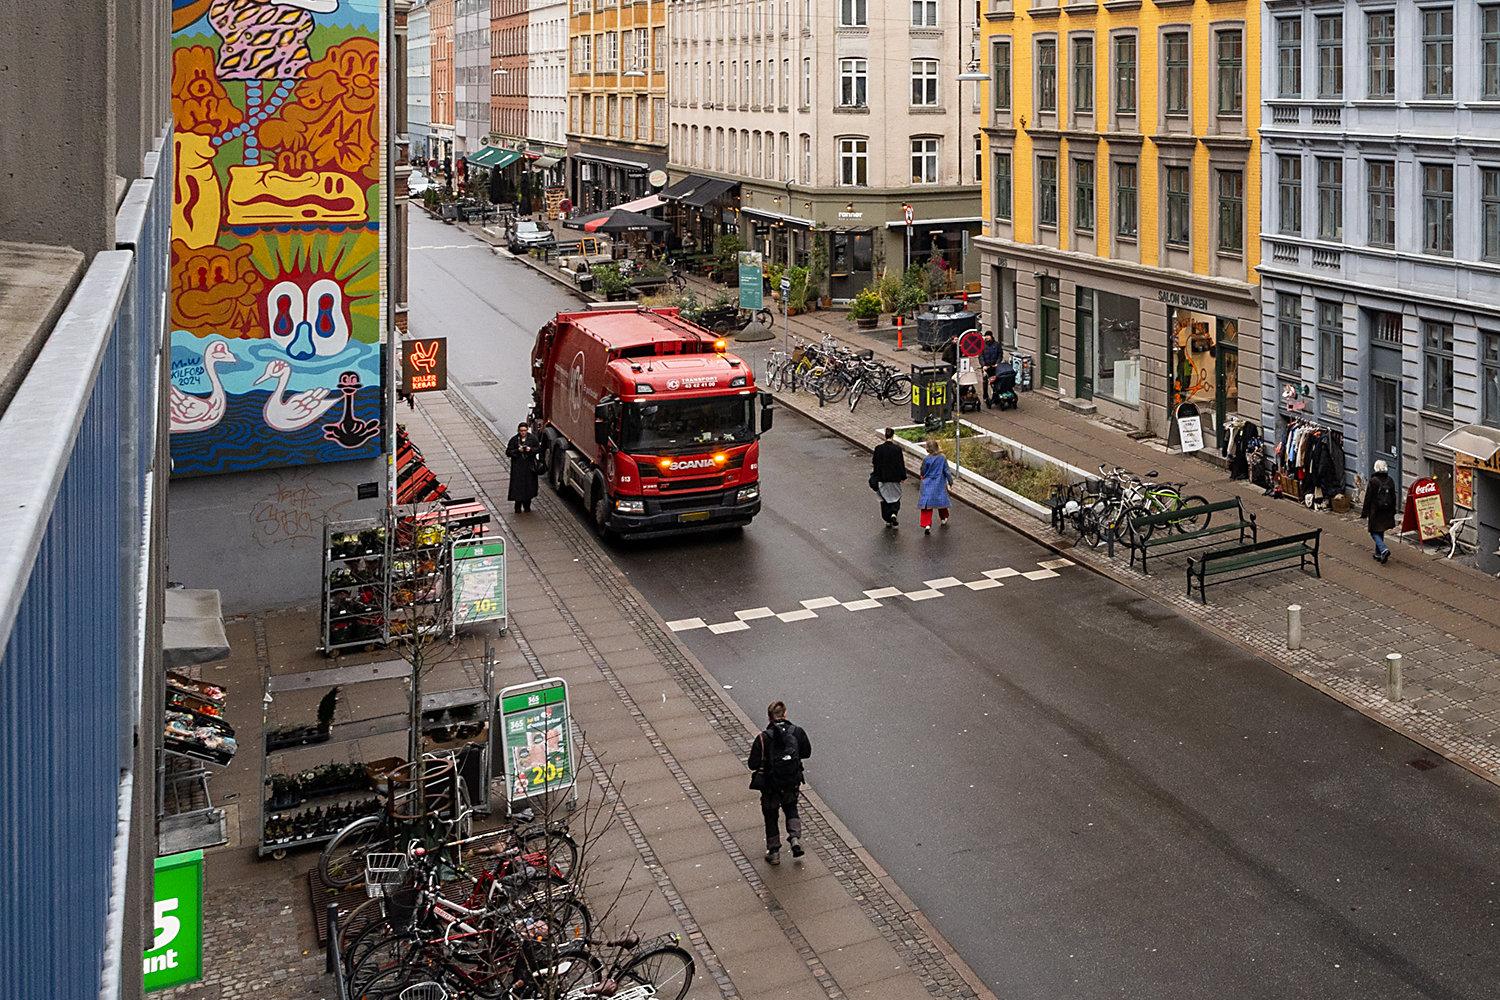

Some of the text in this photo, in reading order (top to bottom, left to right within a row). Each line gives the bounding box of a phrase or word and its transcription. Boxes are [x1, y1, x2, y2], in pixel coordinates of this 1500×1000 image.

[1158, 290, 1208, 310] SALON SAKSEN
[178, 377, 201, 386] 2024
[412, 375, 437, 383] KILLER
[681, 376, 718, 384] TRANSPORT
[412, 382, 437, 390] KEBAB
[669, 458, 716, 471] SCANIA
[528, 695, 539, 704] 365
